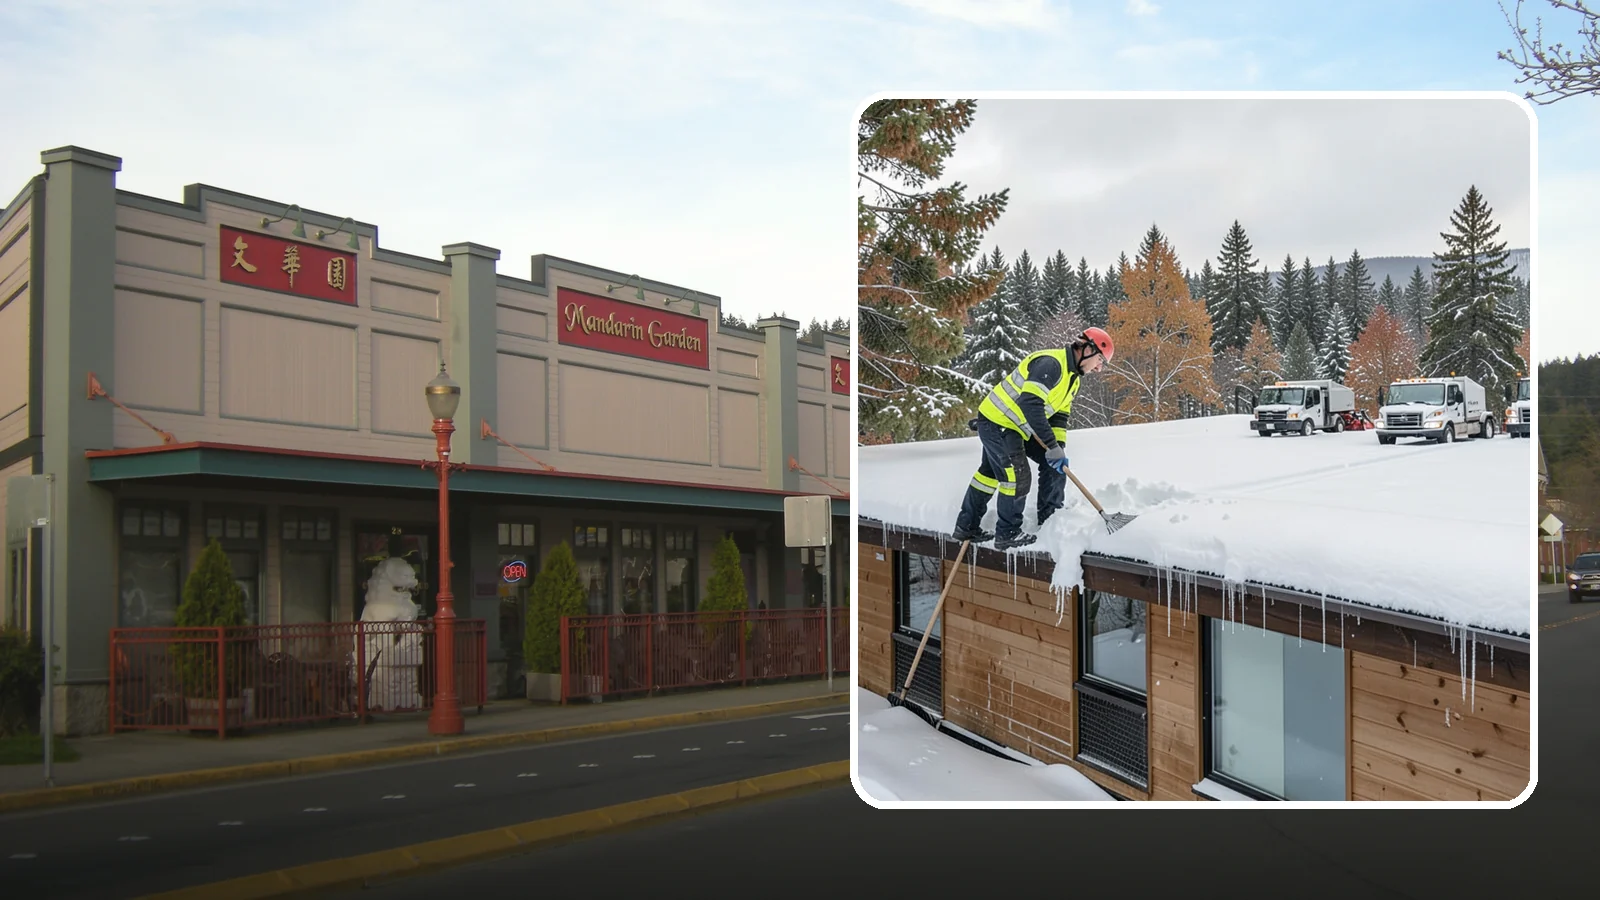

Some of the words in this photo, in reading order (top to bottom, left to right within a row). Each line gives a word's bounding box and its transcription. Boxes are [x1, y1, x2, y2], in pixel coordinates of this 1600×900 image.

[231, 235, 346, 291] 文華園
[564, 302, 644, 341] Mandarin
[647, 320, 702, 352] Garden
[503, 565, 527, 578] OPEN
